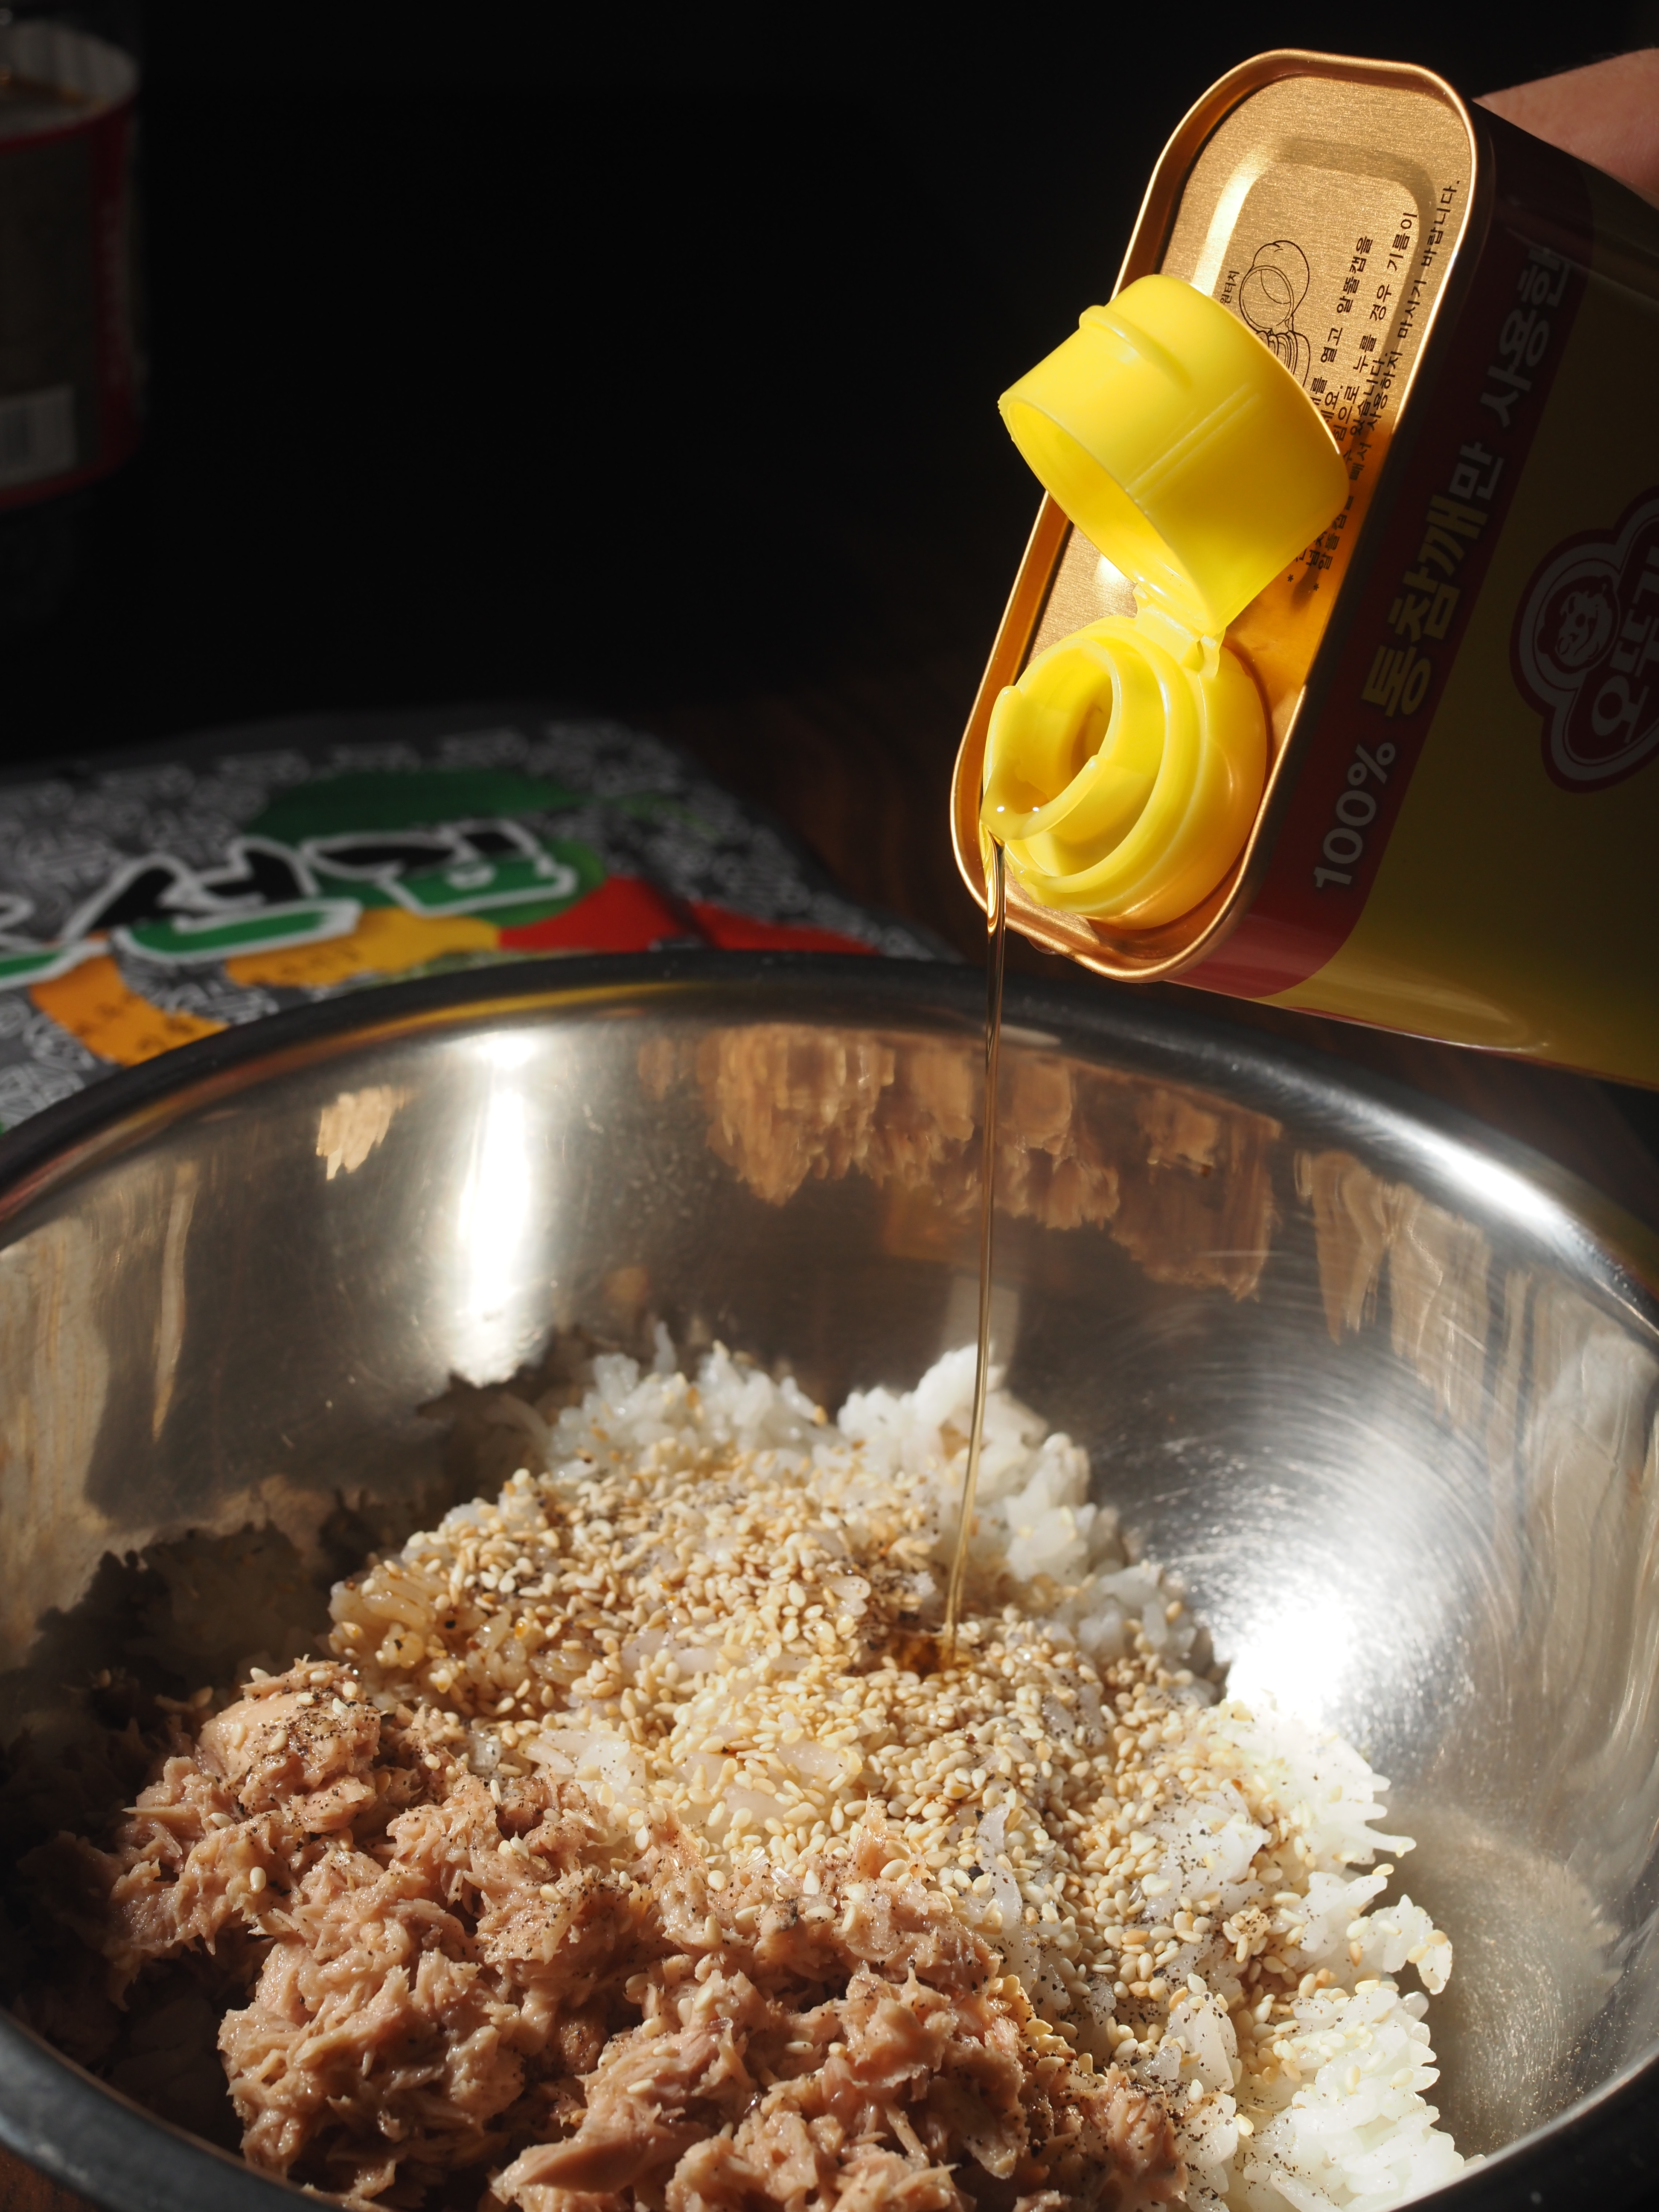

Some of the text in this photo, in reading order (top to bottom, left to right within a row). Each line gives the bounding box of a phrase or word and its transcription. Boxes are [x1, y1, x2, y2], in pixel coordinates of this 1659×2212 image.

[1220, 271, 1240, 306] 원터치
[1320, 327, 1343, 363] 열고
[1333, 212, 1418, 442] 힘으로 누를 경우 기름이
[1349, 442, 1372, 480] 빼서
[1367, 351, 1403, 431] 사용하지
[1397, 279, 1427, 338] 마시기
[1421, 180, 1460, 267] 바랍니다.
[1350, 353, 1388, 436] 있습니다.
[1313, 247, 1571, 888] 100% 통참깨만 사용한
